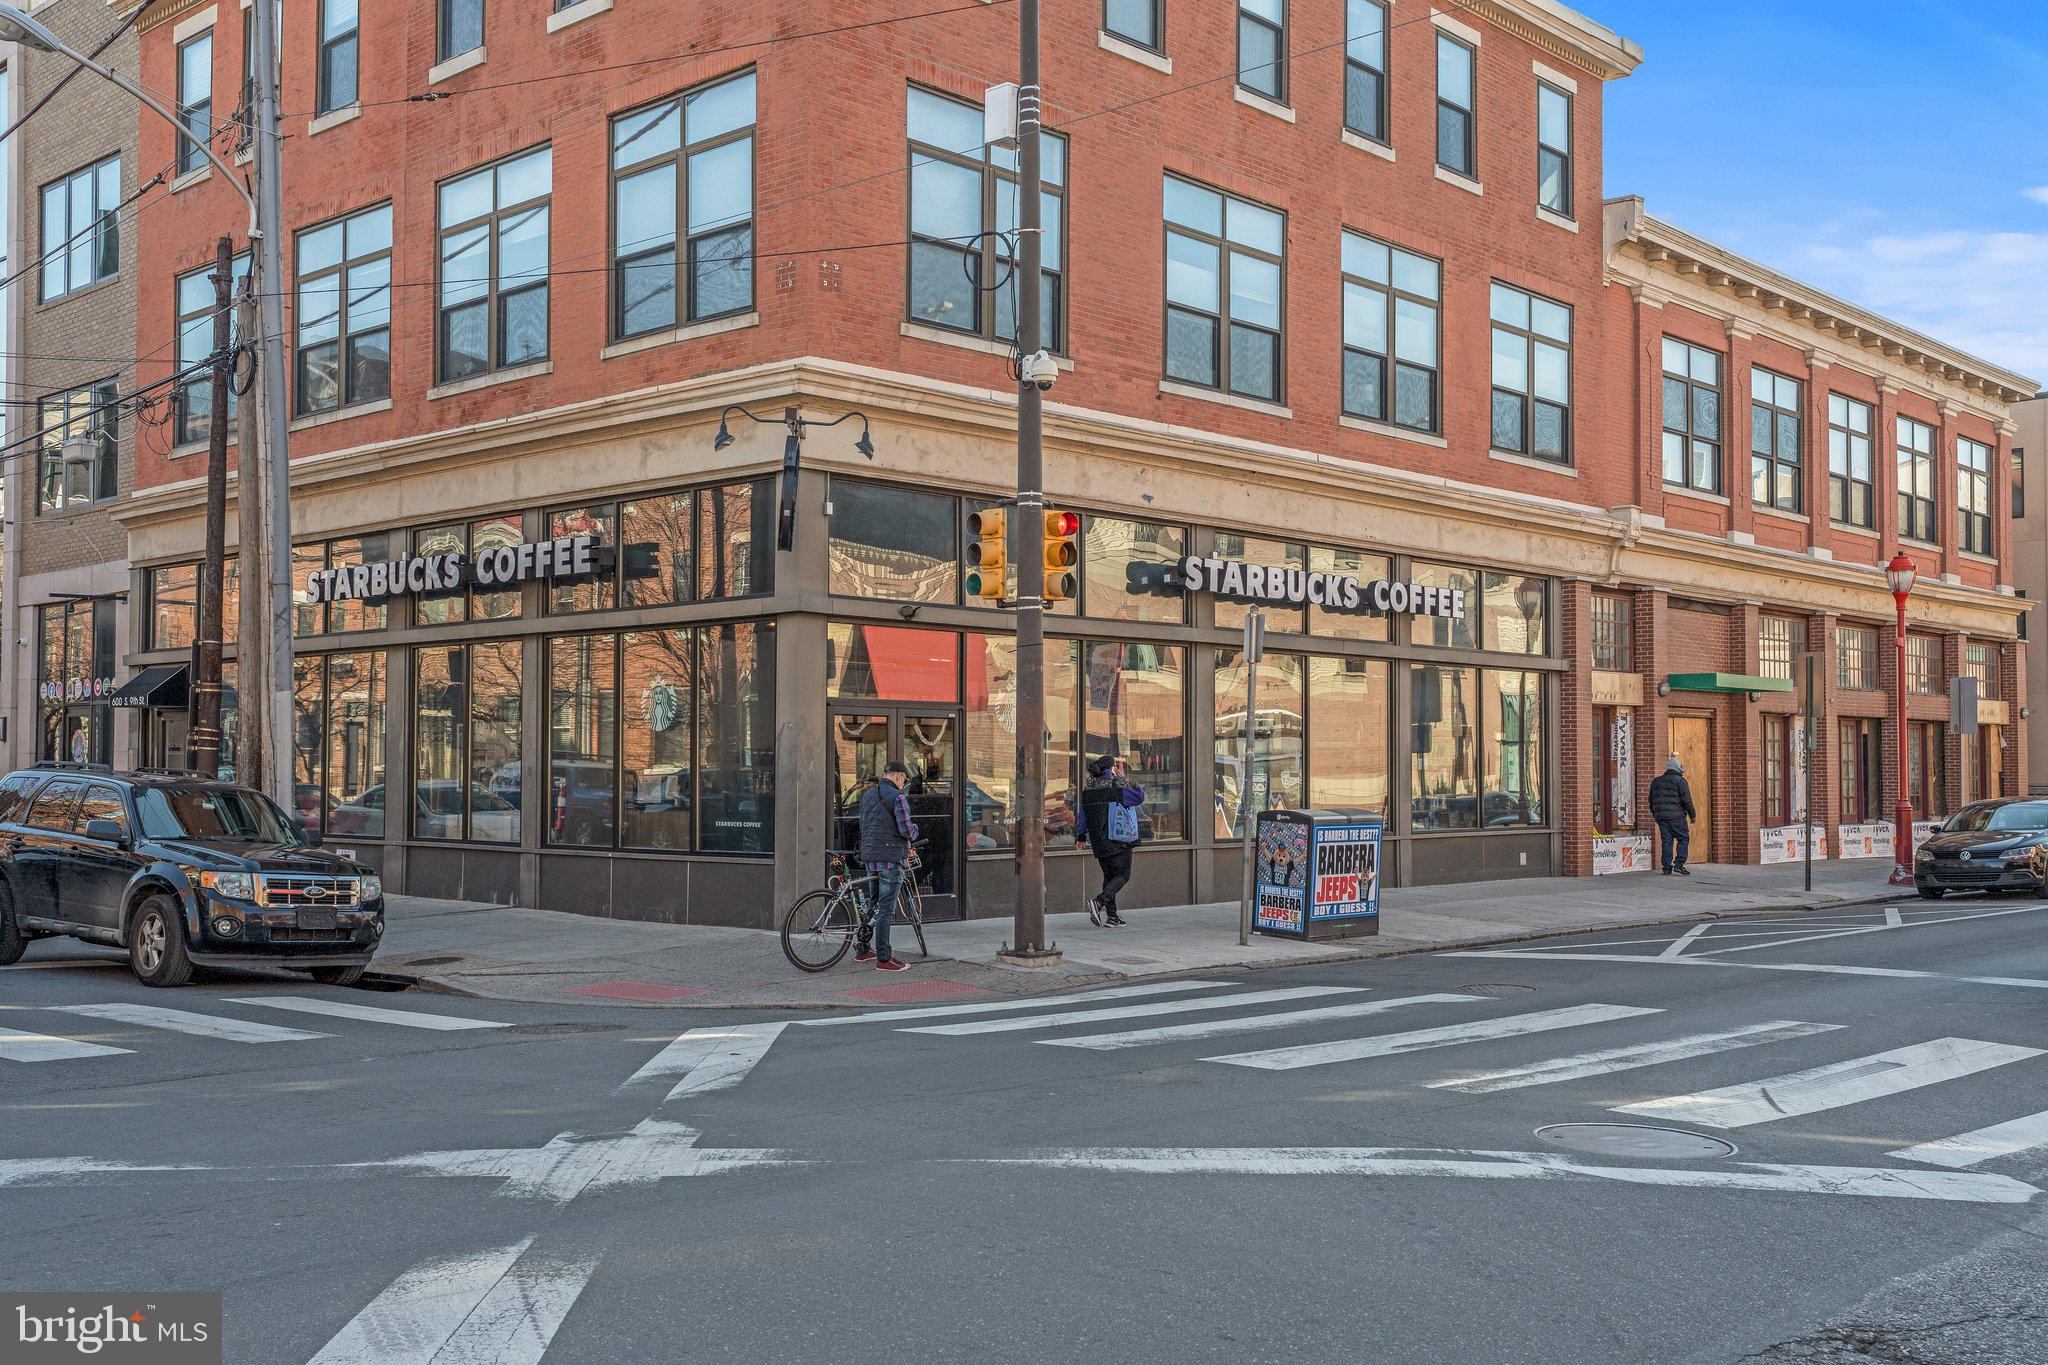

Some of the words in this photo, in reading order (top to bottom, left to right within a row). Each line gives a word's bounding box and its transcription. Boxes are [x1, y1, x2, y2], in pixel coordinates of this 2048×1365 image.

[307, 553, 460, 603] STARBUCKS
[477, 536, 592, 584] COFFEE
[1184, 556, 1360, 608] STARBUCKS
[1374, 580, 1464, 618] COFFEE
[112, 697, 122, 707] 600
[1325, 830, 1348, 841] BARBERA
[1350, 830, 1359, 840] THE
[1317, 844, 1375, 875] BARBERA
[1316, 875, 1357, 903] JEEPS
[1260, 894, 1301, 911] BARBERA
[1314, 905, 1331, 916] BOY
[1333, 905, 1337, 914] I
[1339, 902, 1366, 913] GUESS
[1259, 907, 1289, 921] JEEPS
[1275, 920, 1295, 929] GUESS
